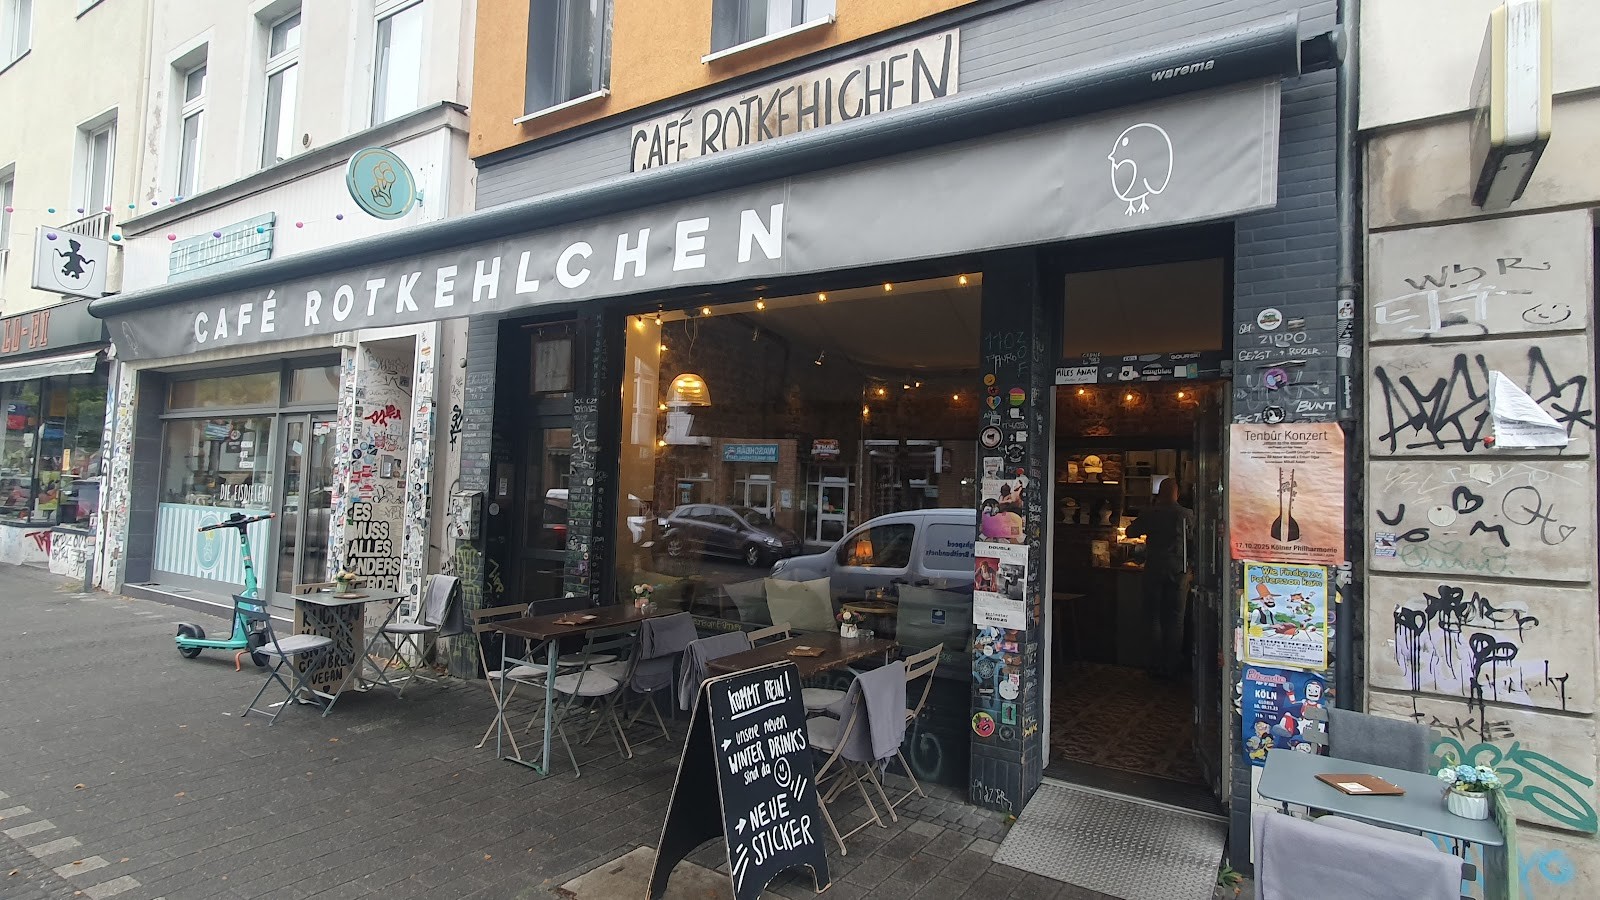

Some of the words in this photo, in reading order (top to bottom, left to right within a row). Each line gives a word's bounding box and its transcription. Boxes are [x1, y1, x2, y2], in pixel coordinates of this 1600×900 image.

[1150, 59, 1215, 82] warema
[629, 108, 694, 174] CAFÉ
[176, 244, 191, 272] DIE
[193, 288, 277, 344] CAFÉ
[303, 203, 784, 327] ROTKEHLCHEN
[1296, 400, 1336, 413] BUNT
[1284, 430, 1328, 441] Konzert
[220, 484, 231, 501] DIE
[353, 502, 372, 522] ES
[348, 539, 392, 558] ALLES
[1235, 542, 1270, 550] 17.10.2025
[1270, 543, 1292, 551] Kölner
[1262, 566, 1278, 576] Wie
[1280, 568, 1309, 578] Findus
[1301, 579, 1323, 587] kam
[311, 668, 343, 684] VEGAN
[728, 683, 760, 714] KOMMT
[1255, 688, 1277, 700] KÖLN
[735, 723, 760, 746] unsere
[764, 714, 787, 733] neuen
[728, 741, 765, 775] WINTER
[768, 728, 806, 760] DRINKS
[743, 766, 759, 786] sind
[761, 763, 771, 778] da
[749, 793, 790, 832] NEUE
[752, 814, 815, 867] STICKER
